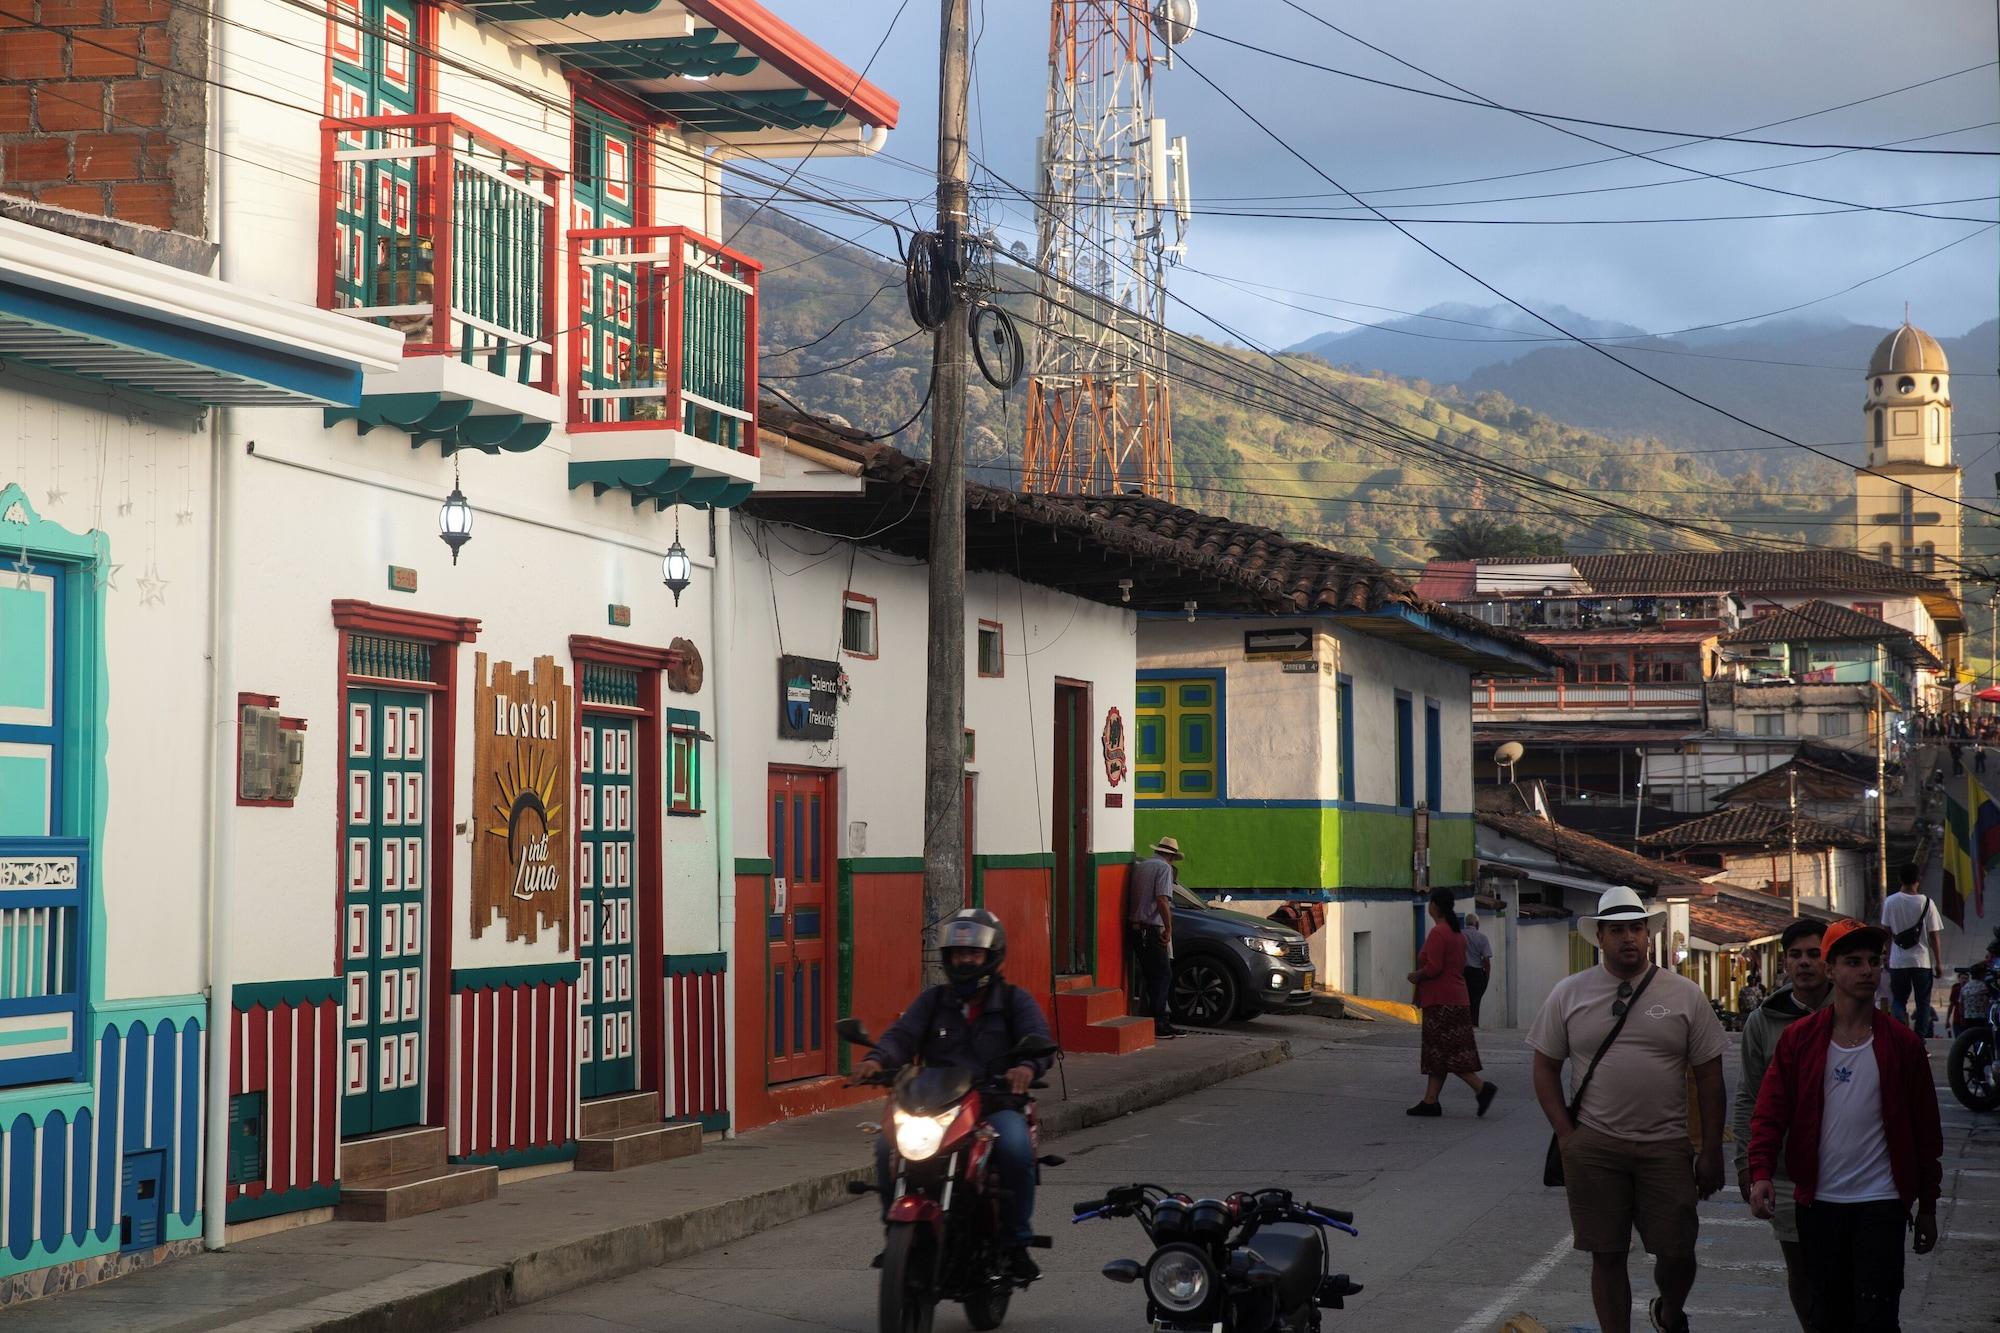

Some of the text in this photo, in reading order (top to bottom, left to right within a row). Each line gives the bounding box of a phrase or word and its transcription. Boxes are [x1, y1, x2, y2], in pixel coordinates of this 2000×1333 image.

[811, 674, 837, 693] Salento
[495, 694, 557, 740] Hostal
[513, 845, 560, 901] Luna
